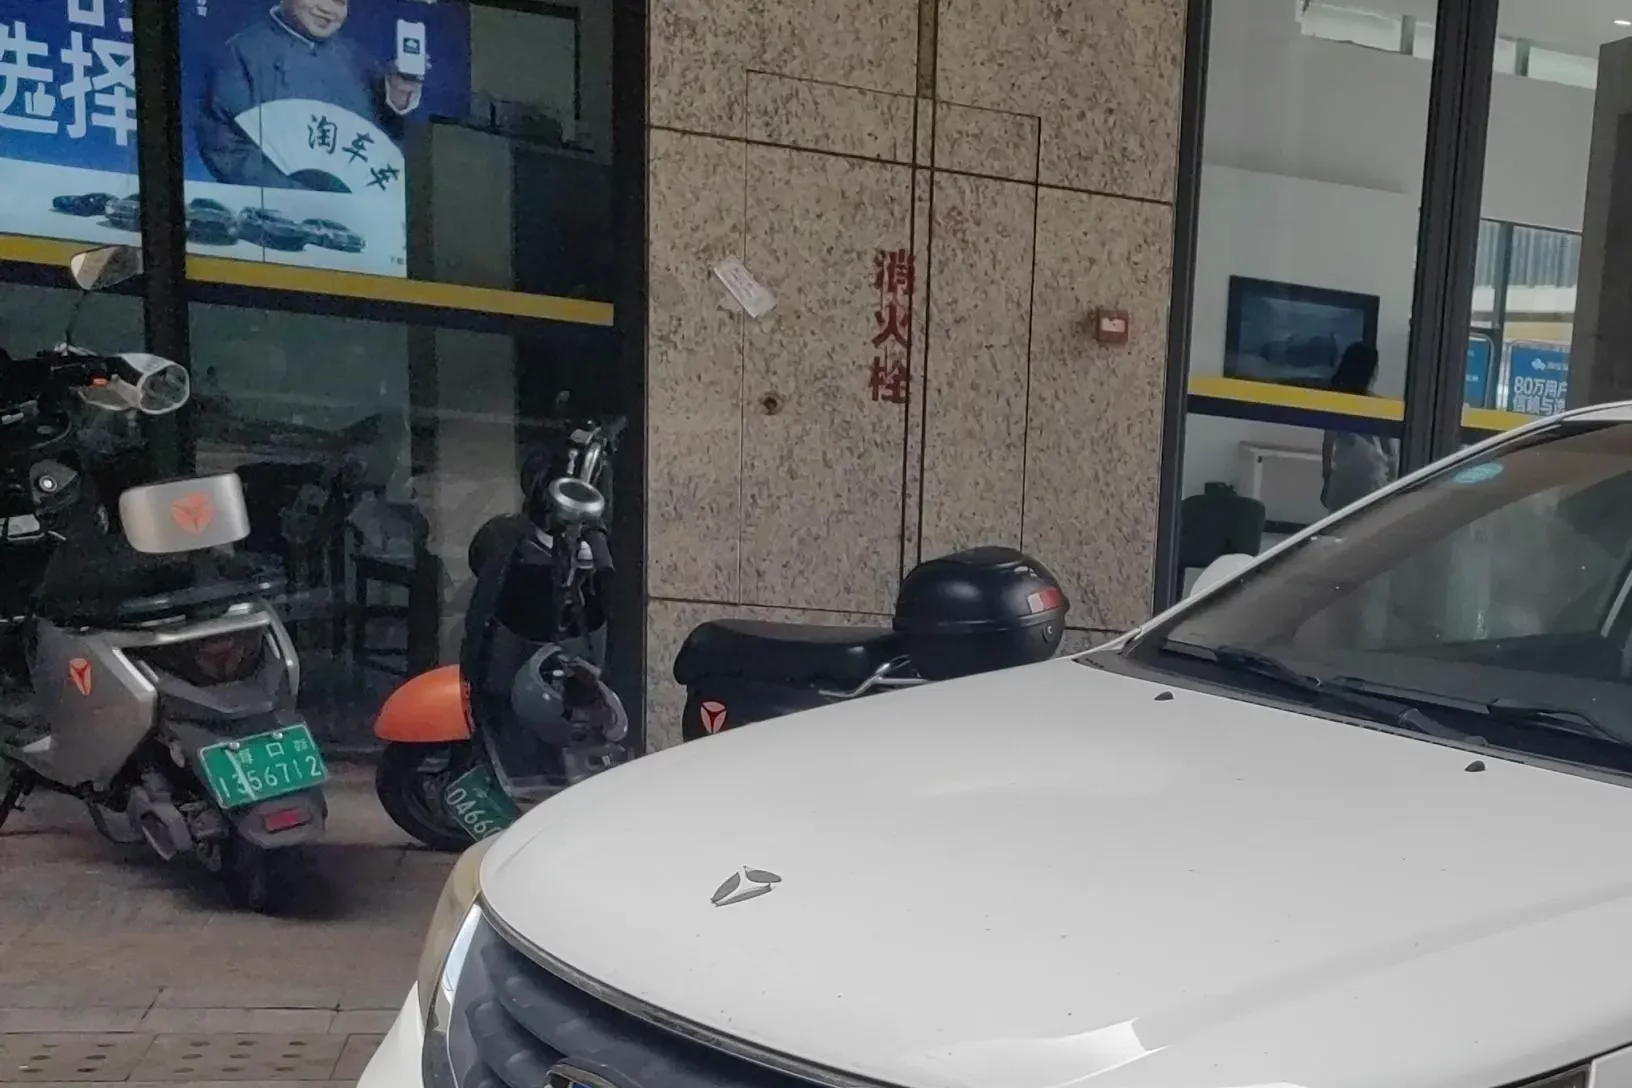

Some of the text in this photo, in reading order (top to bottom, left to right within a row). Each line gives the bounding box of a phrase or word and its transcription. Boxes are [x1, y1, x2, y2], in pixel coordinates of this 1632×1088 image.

[307, 114, 400, 191] 淘车车
[868, 248, 915, 403] 消火栓
[219, 755, 322, 799] 1356712
